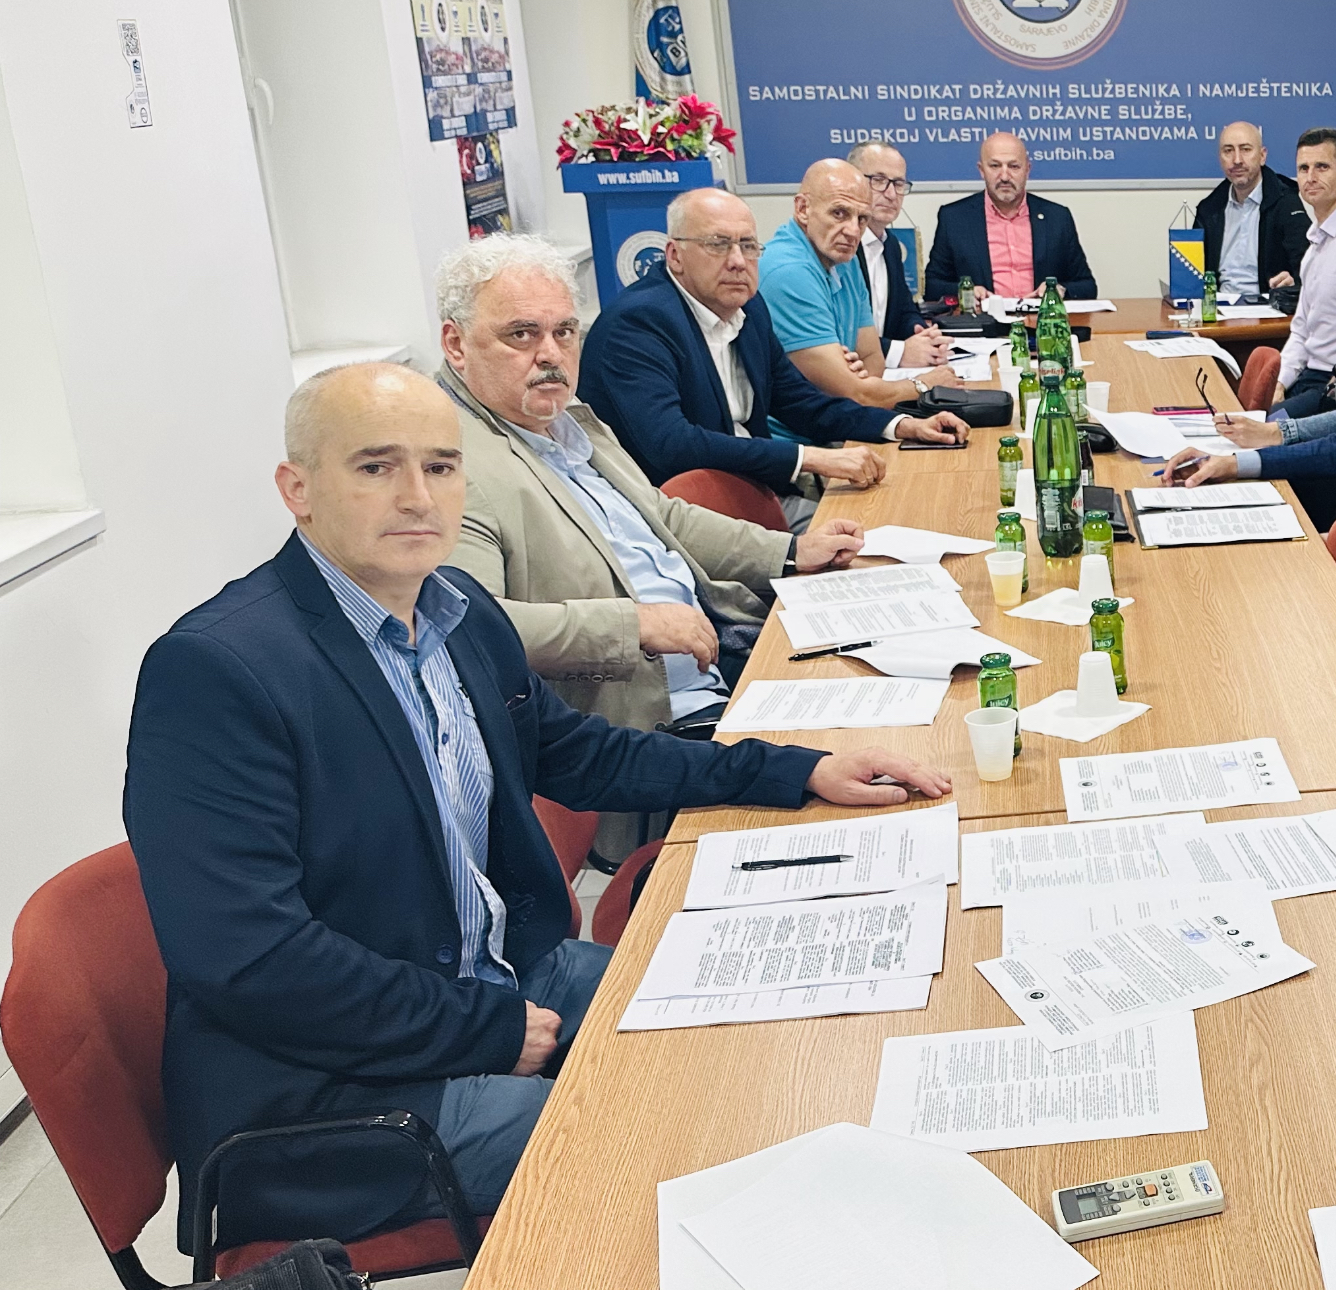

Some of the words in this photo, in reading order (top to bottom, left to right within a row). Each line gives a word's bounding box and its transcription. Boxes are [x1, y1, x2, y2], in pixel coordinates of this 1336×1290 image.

[1019, 24, 1068, 36] SARAJEVO
[748, 85, 869, 100] SAMOSTALNI
[877, 85, 962, 100] SINDIKAT
[970, 80, 1060, 99] DRŽAVNIH
[1068, 79, 1181, 98] SLUŽBENIKA
[1187, 84, 1191, 97] I
[1199, 78, 1333, 98] NAMJEŠTENIKA
[904, 107, 916, 121] U
[924, 106, 1022, 120] ORGANIMA
[1029, 100, 1111, 120] DRŽAVNE
[1118, 100, 1192, 121] SLUŽBE,
[830, 128, 920, 144] SUDSKOJ
[925, 128, 987, 142] VLASTI
[1079, 126, 1198, 141] USTANOVAMA
[1205, 126, 1216, 139] U
[597, 169, 679, 185] www.sufbih.ba
